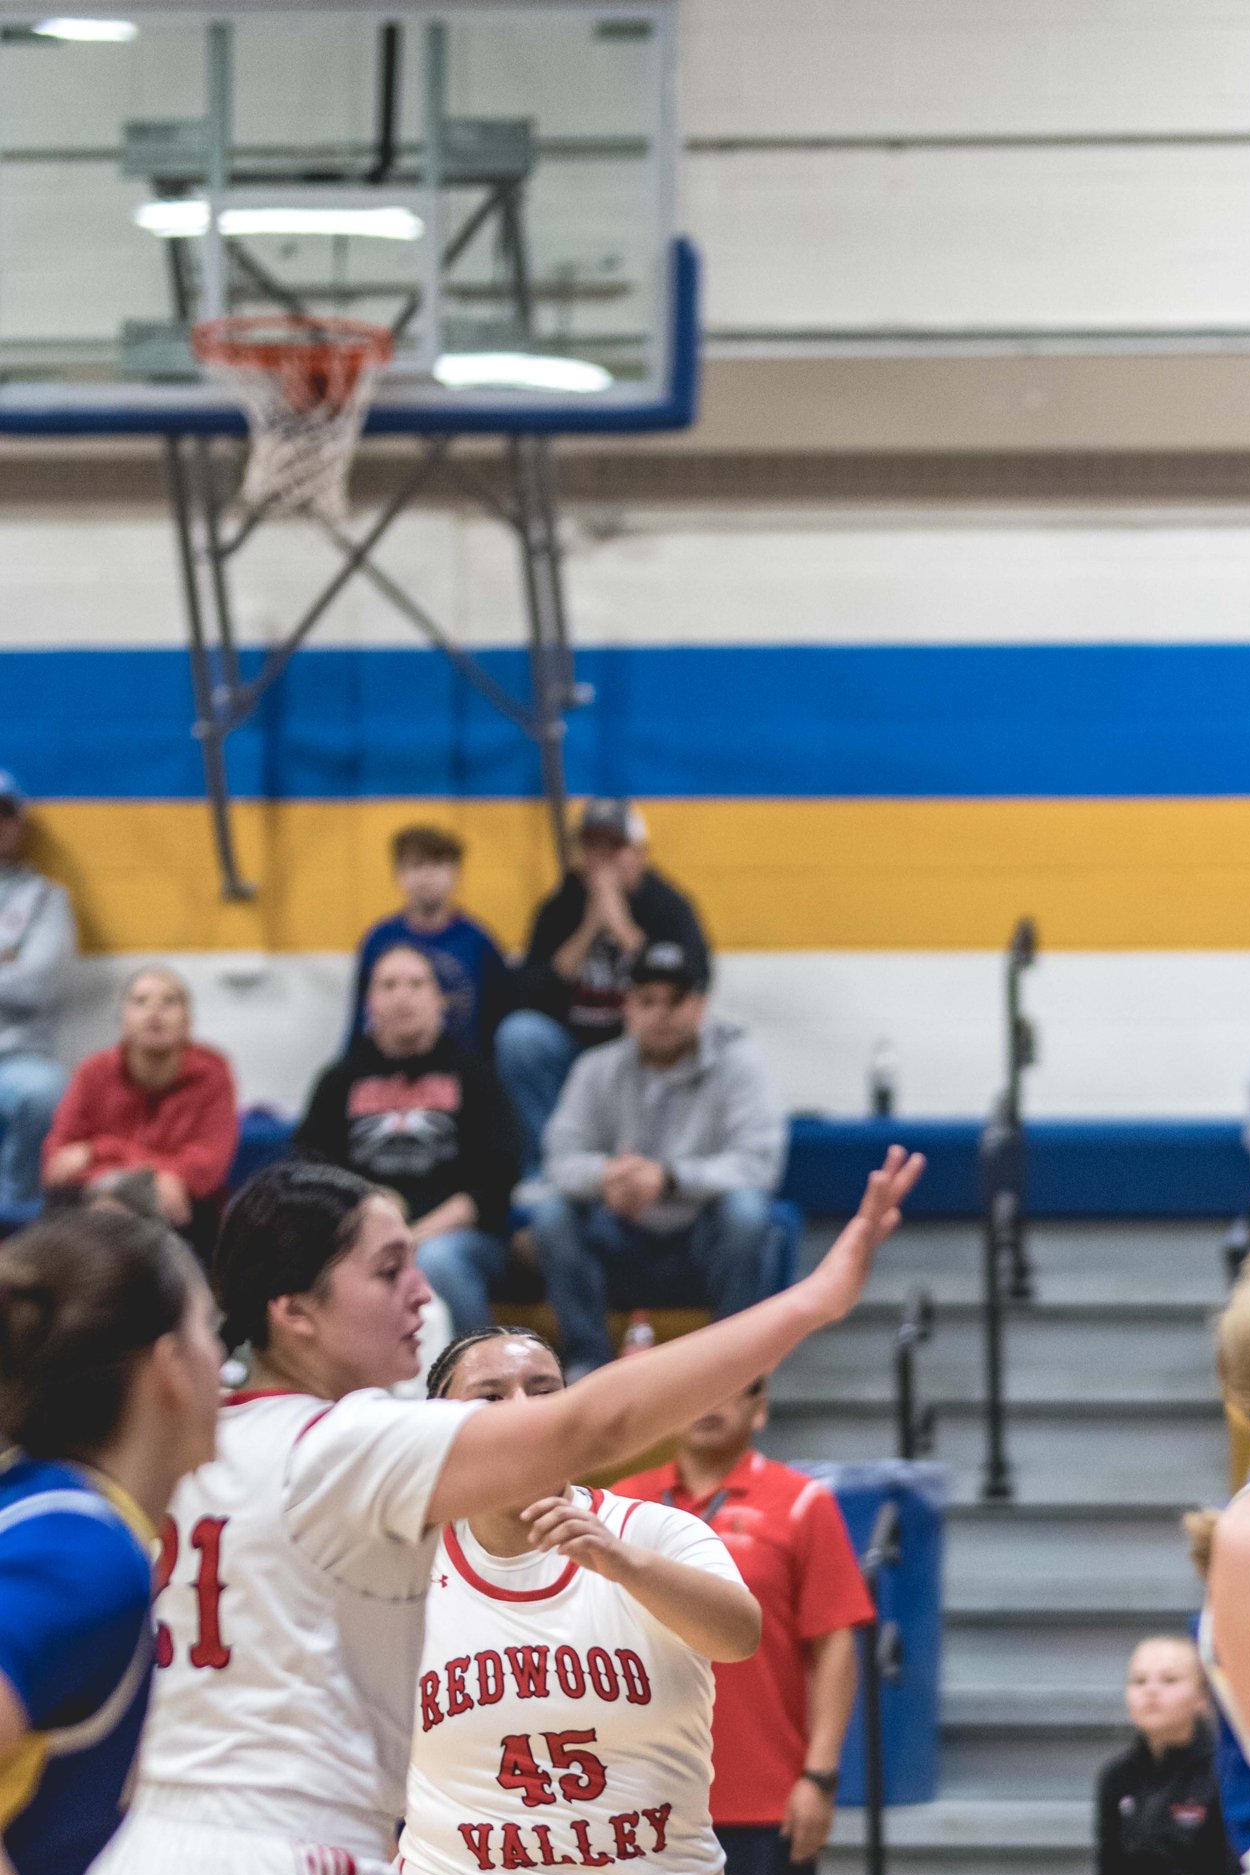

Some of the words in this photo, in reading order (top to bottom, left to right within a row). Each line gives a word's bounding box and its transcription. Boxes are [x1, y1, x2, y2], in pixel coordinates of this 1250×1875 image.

[420, 1645, 651, 1732] REDWOOD
[496, 1728, 608, 1807] 45
[458, 1803, 672, 1870] VALLEY
